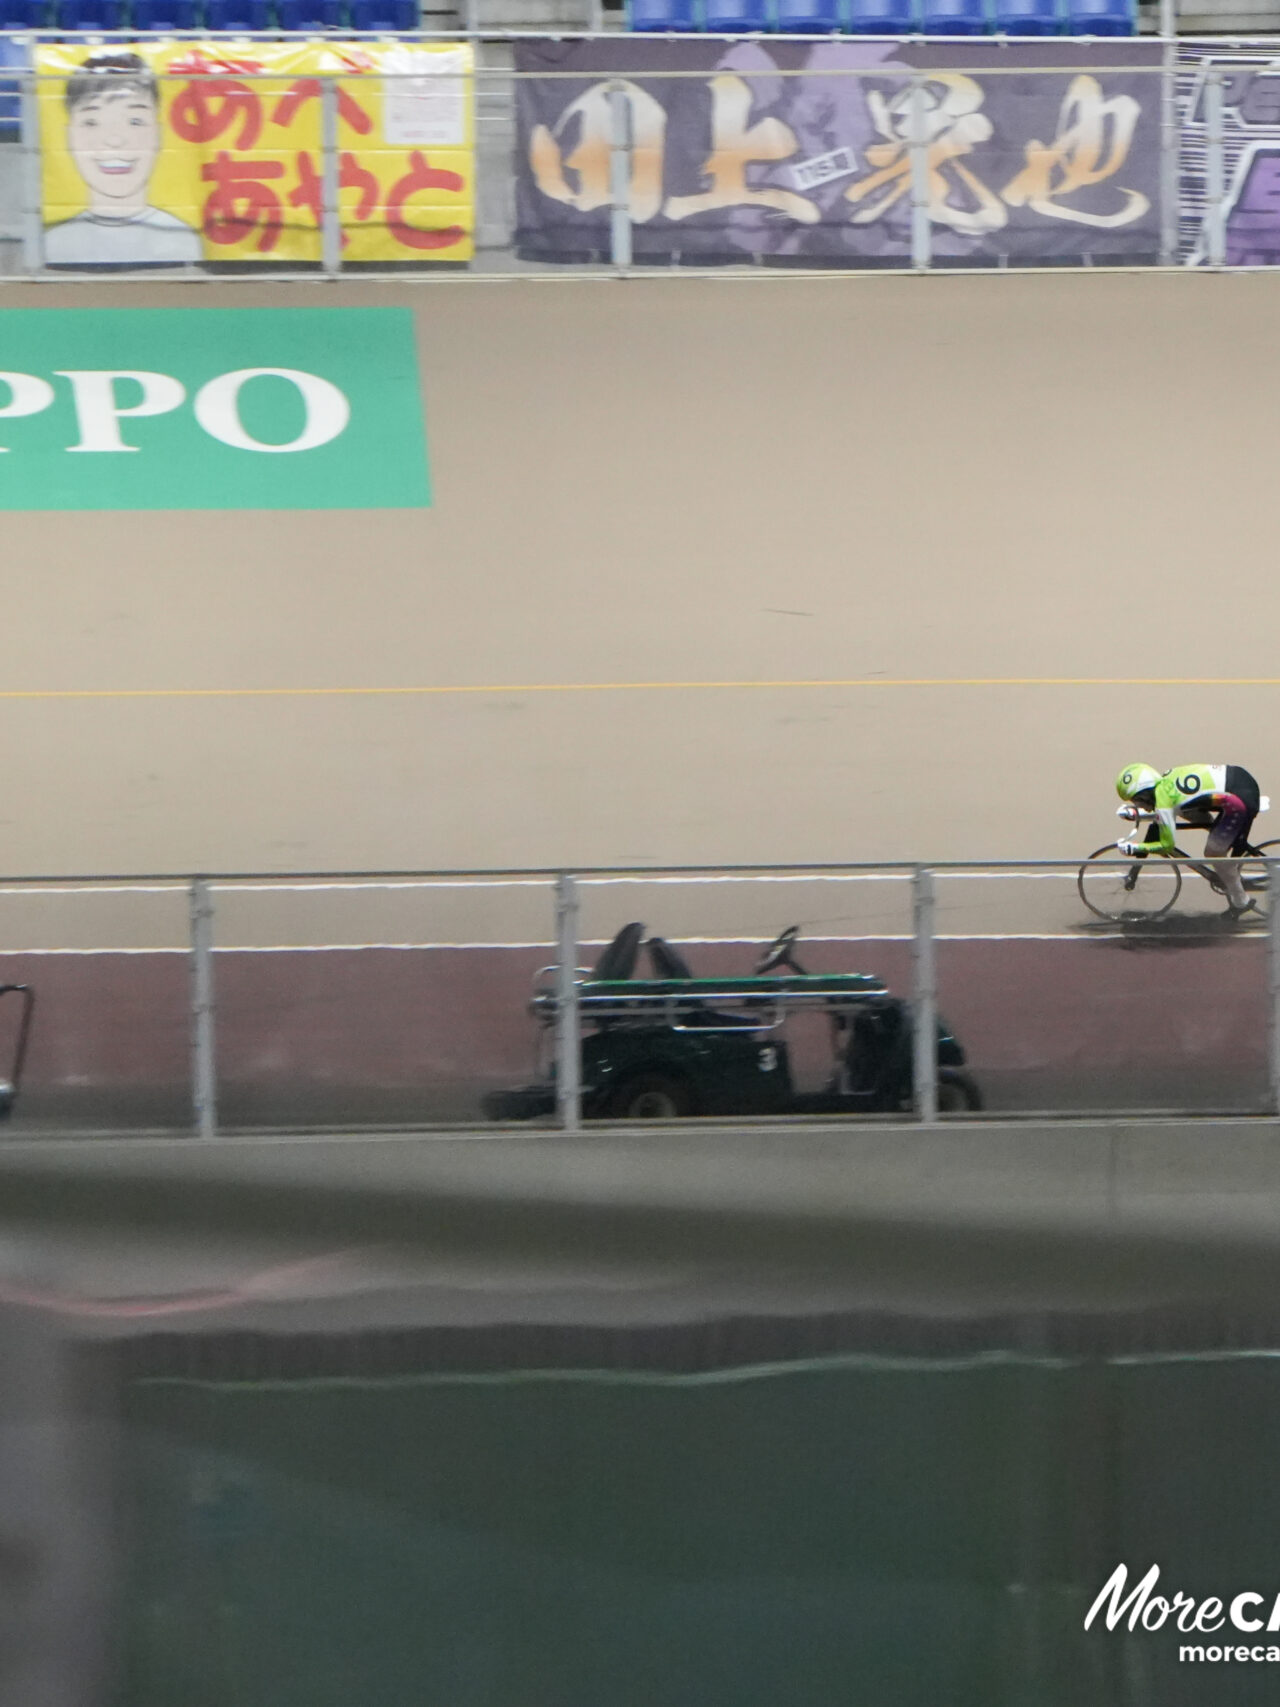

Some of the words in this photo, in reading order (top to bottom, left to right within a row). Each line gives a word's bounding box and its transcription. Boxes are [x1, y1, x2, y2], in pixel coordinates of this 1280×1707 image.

[167, 50, 373, 151] あべ
[201, 150, 466, 252] あやと
[1123, 774, 1132, 785] 6
[1175, 774, 1201, 795] 6
[758, 1047, 778, 1071] 3
